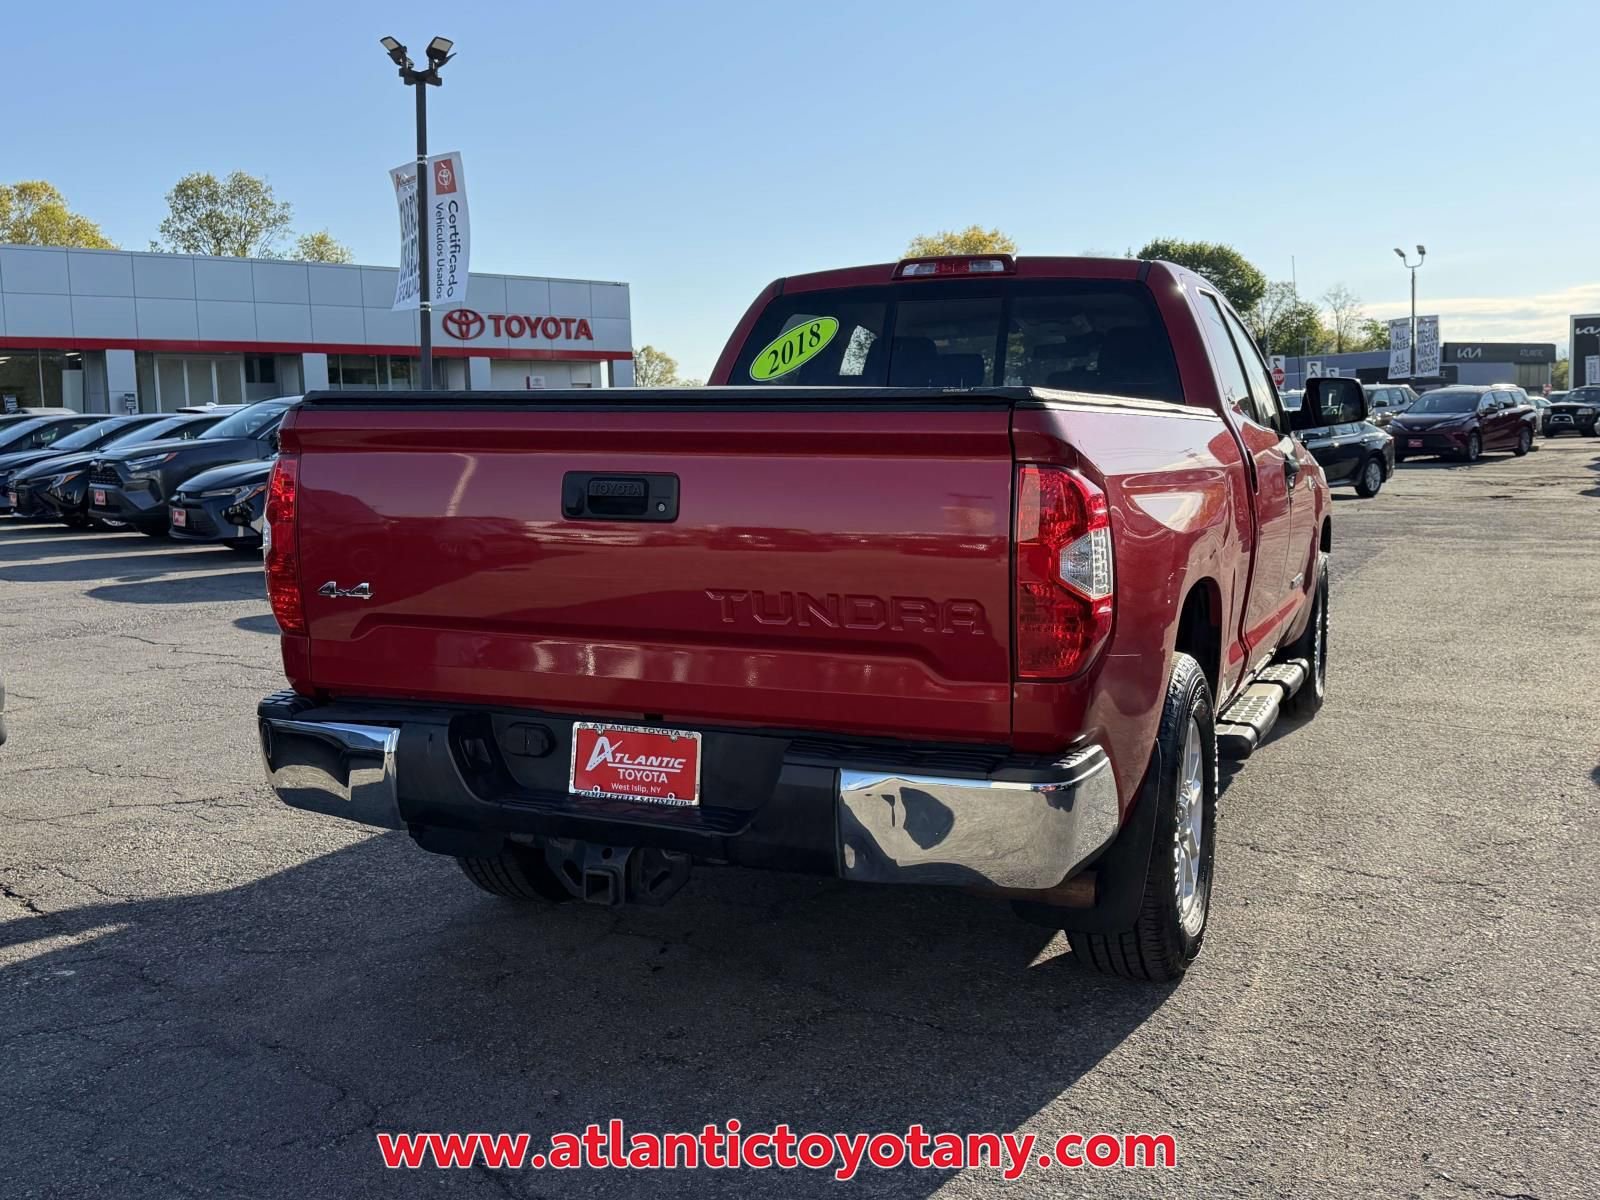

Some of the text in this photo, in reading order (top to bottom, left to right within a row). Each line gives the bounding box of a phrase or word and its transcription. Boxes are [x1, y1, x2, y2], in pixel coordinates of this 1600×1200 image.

[447, 200, 460, 298] Certificado
[436, 258, 445, 299] Usados
[488, 314, 594, 340] TOYOTA
[767, 322, 822, 376] 2018
[1457, 347, 1482, 359] KIA
[592, 481, 642, 496] TOYOTA
[316, 580, 374, 600] 4x4
[705, 588, 986, 635] TUNDRA
[592, 723, 681, 737] ATLANTIC TOYOTA
[585, 736, 687, 771] ATLANTIC
[611, 782, 662, 793] West Islip, NY
[617, 768, 668, 784] TOYOTA
